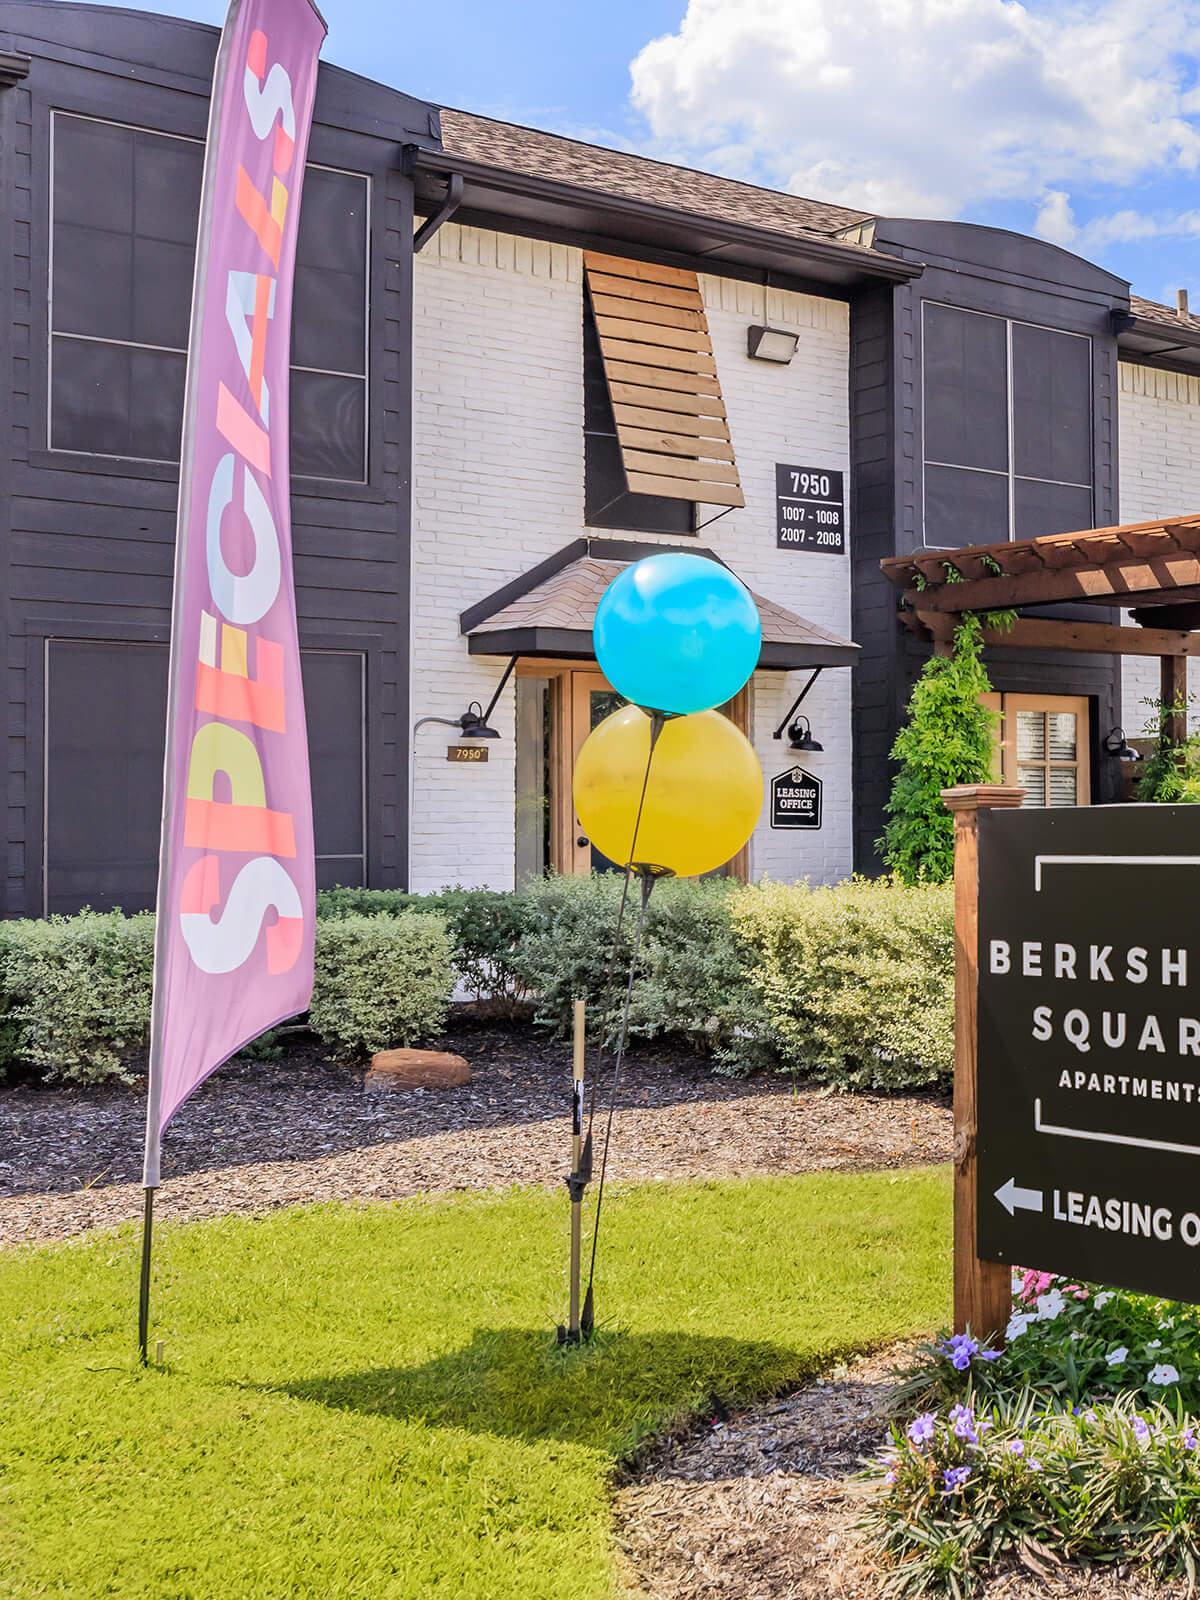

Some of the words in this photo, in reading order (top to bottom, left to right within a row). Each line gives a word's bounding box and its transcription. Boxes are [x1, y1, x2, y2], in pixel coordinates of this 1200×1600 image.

[790, 471, 829, 497] 7950
[179, 30, 304, 976] SPECIALS
[782, 506, 805, 521] 1007
[816, 510, 839, 525] 1008
[781, 527, 805, 543] 2007
[816, 531, 842, 546] 2008
[456, 749, 481, 759] 7950
[776, 788, 816, 798] LEASING
[780, 799, 813, 809] OFFICE
[1052, 1189, 1173, 1241] LEASING
